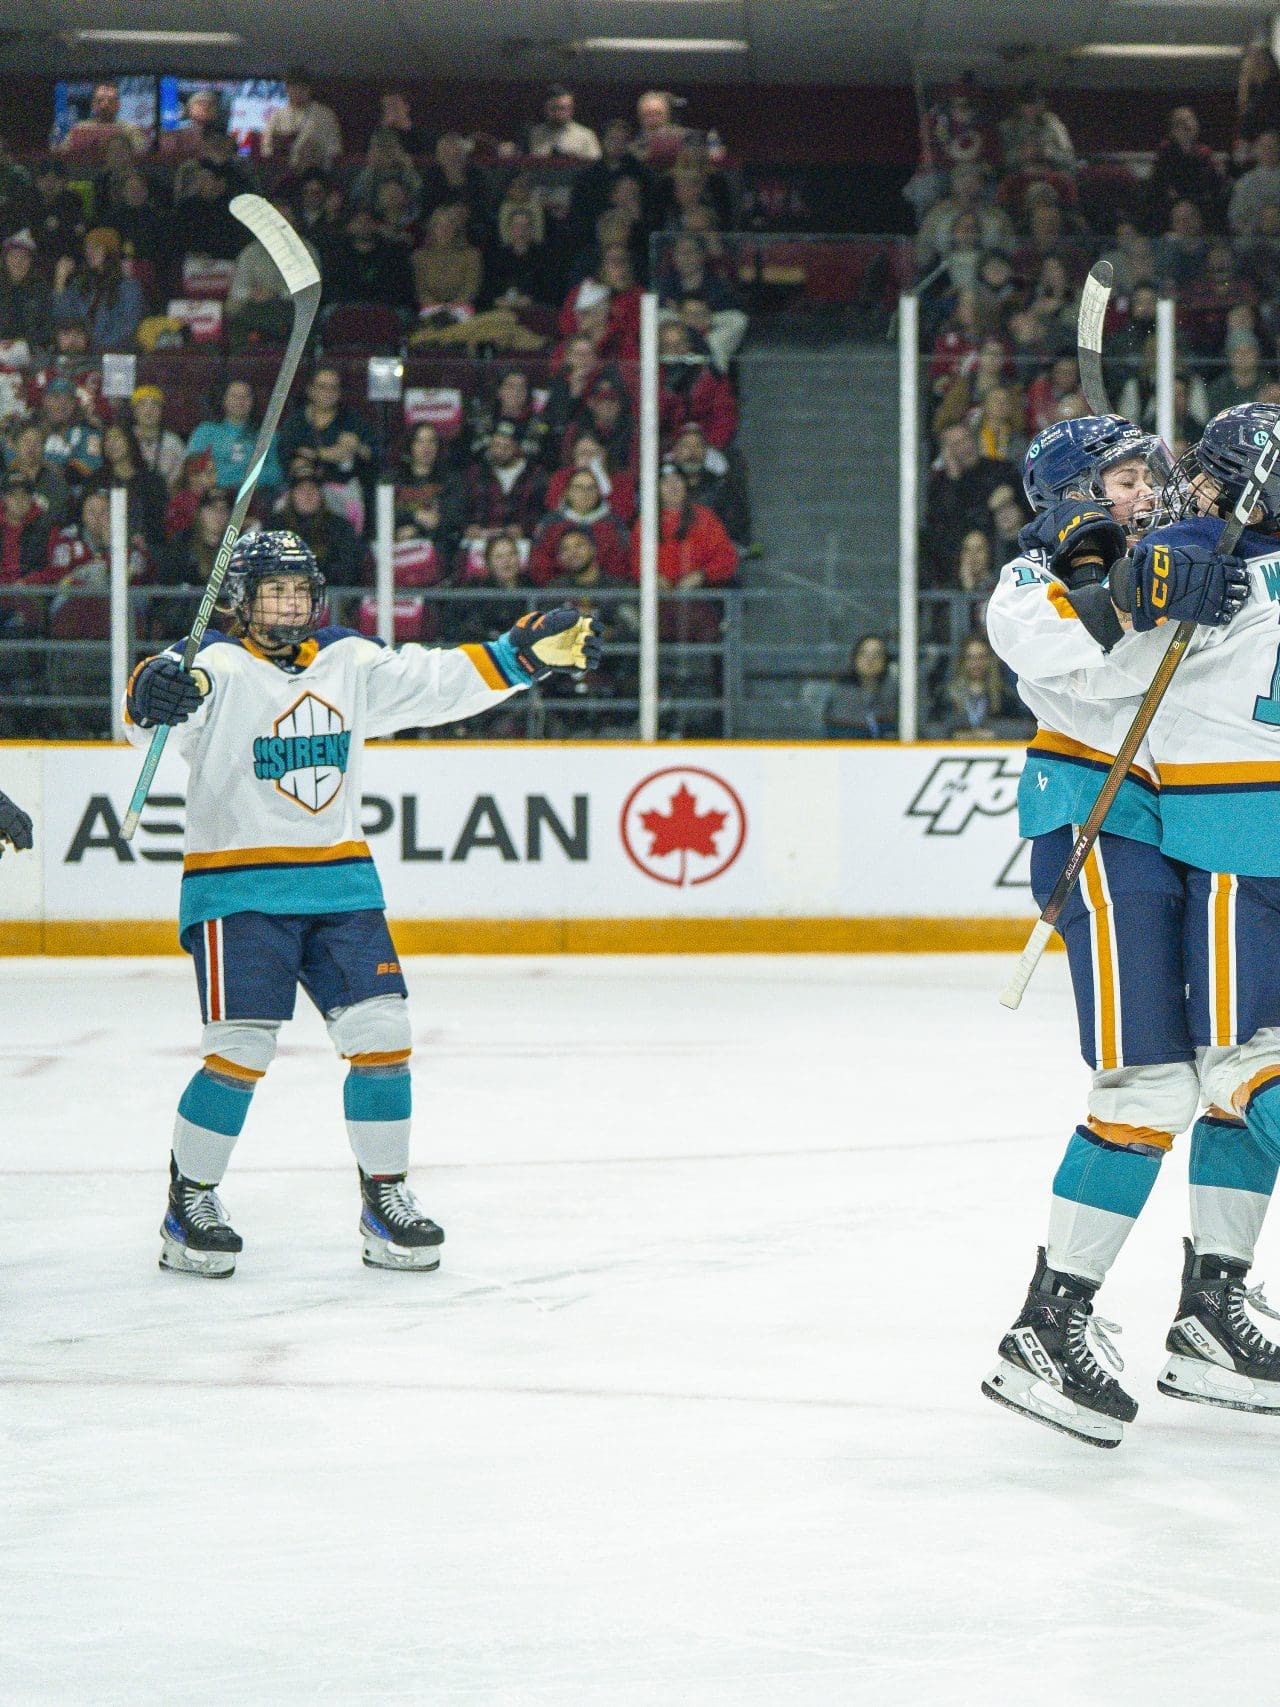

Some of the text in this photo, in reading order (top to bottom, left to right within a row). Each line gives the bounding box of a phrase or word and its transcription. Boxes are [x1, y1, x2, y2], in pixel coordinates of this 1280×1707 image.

[253, 730, 351, 780] SIRENS
[1022, 1331, 1061, 1387] CCM
[1183, 1321, 1217, 1356] CCM
